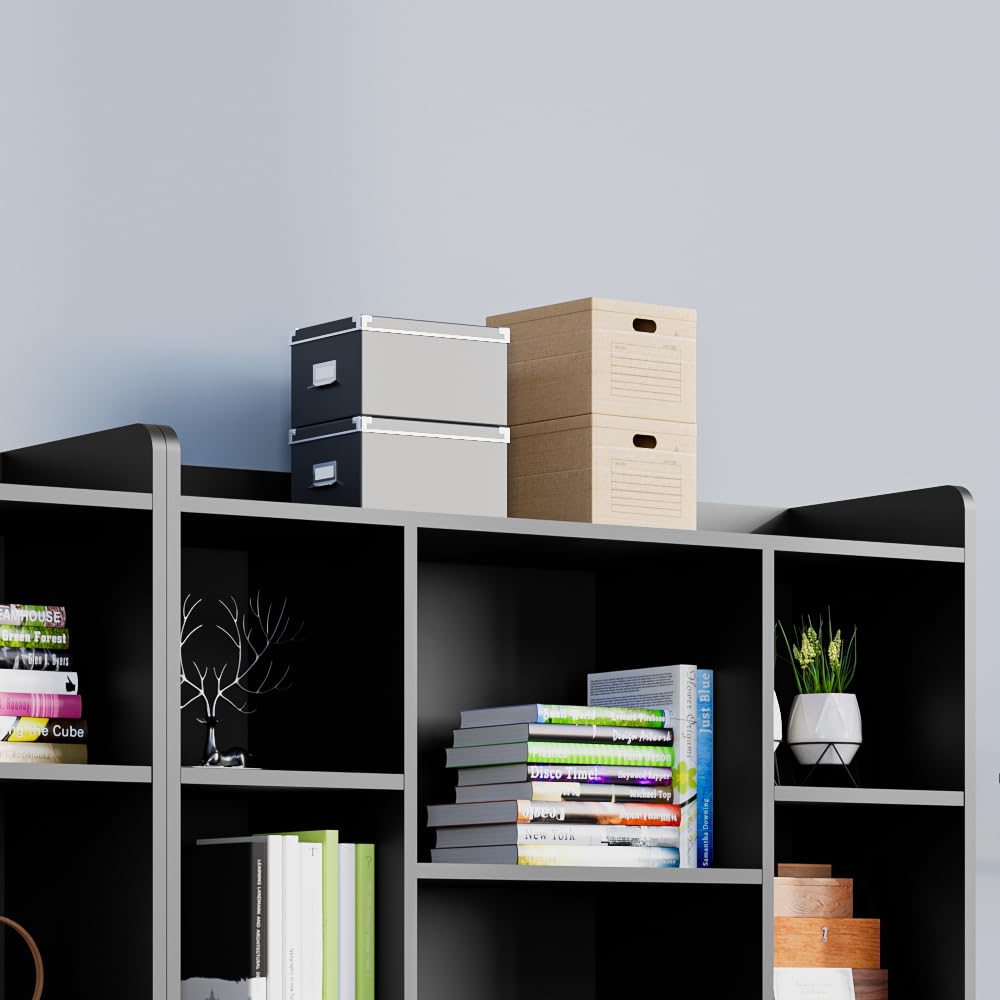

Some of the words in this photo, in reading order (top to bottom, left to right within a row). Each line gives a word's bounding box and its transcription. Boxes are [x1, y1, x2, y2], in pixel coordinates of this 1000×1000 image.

[2, 629, 31, 643] Green
[34, 630, 67, 645] Forest
[698, 672, 712, 703] Blue
[699, 707, 713, 734] Just
[29, 724, 49, 737] the
[52, 723, 86, 739] Cube
[530, 766, 563, 781] Disco
[565, 767, 600, 782] Time!
[659, 790, 672, 801] Top
[702, 797, 711, 830] Downing
[524, 830, 548, 841] New
[552, 829, 577, 841] York
[702, 832, 710, 867] Samantha
